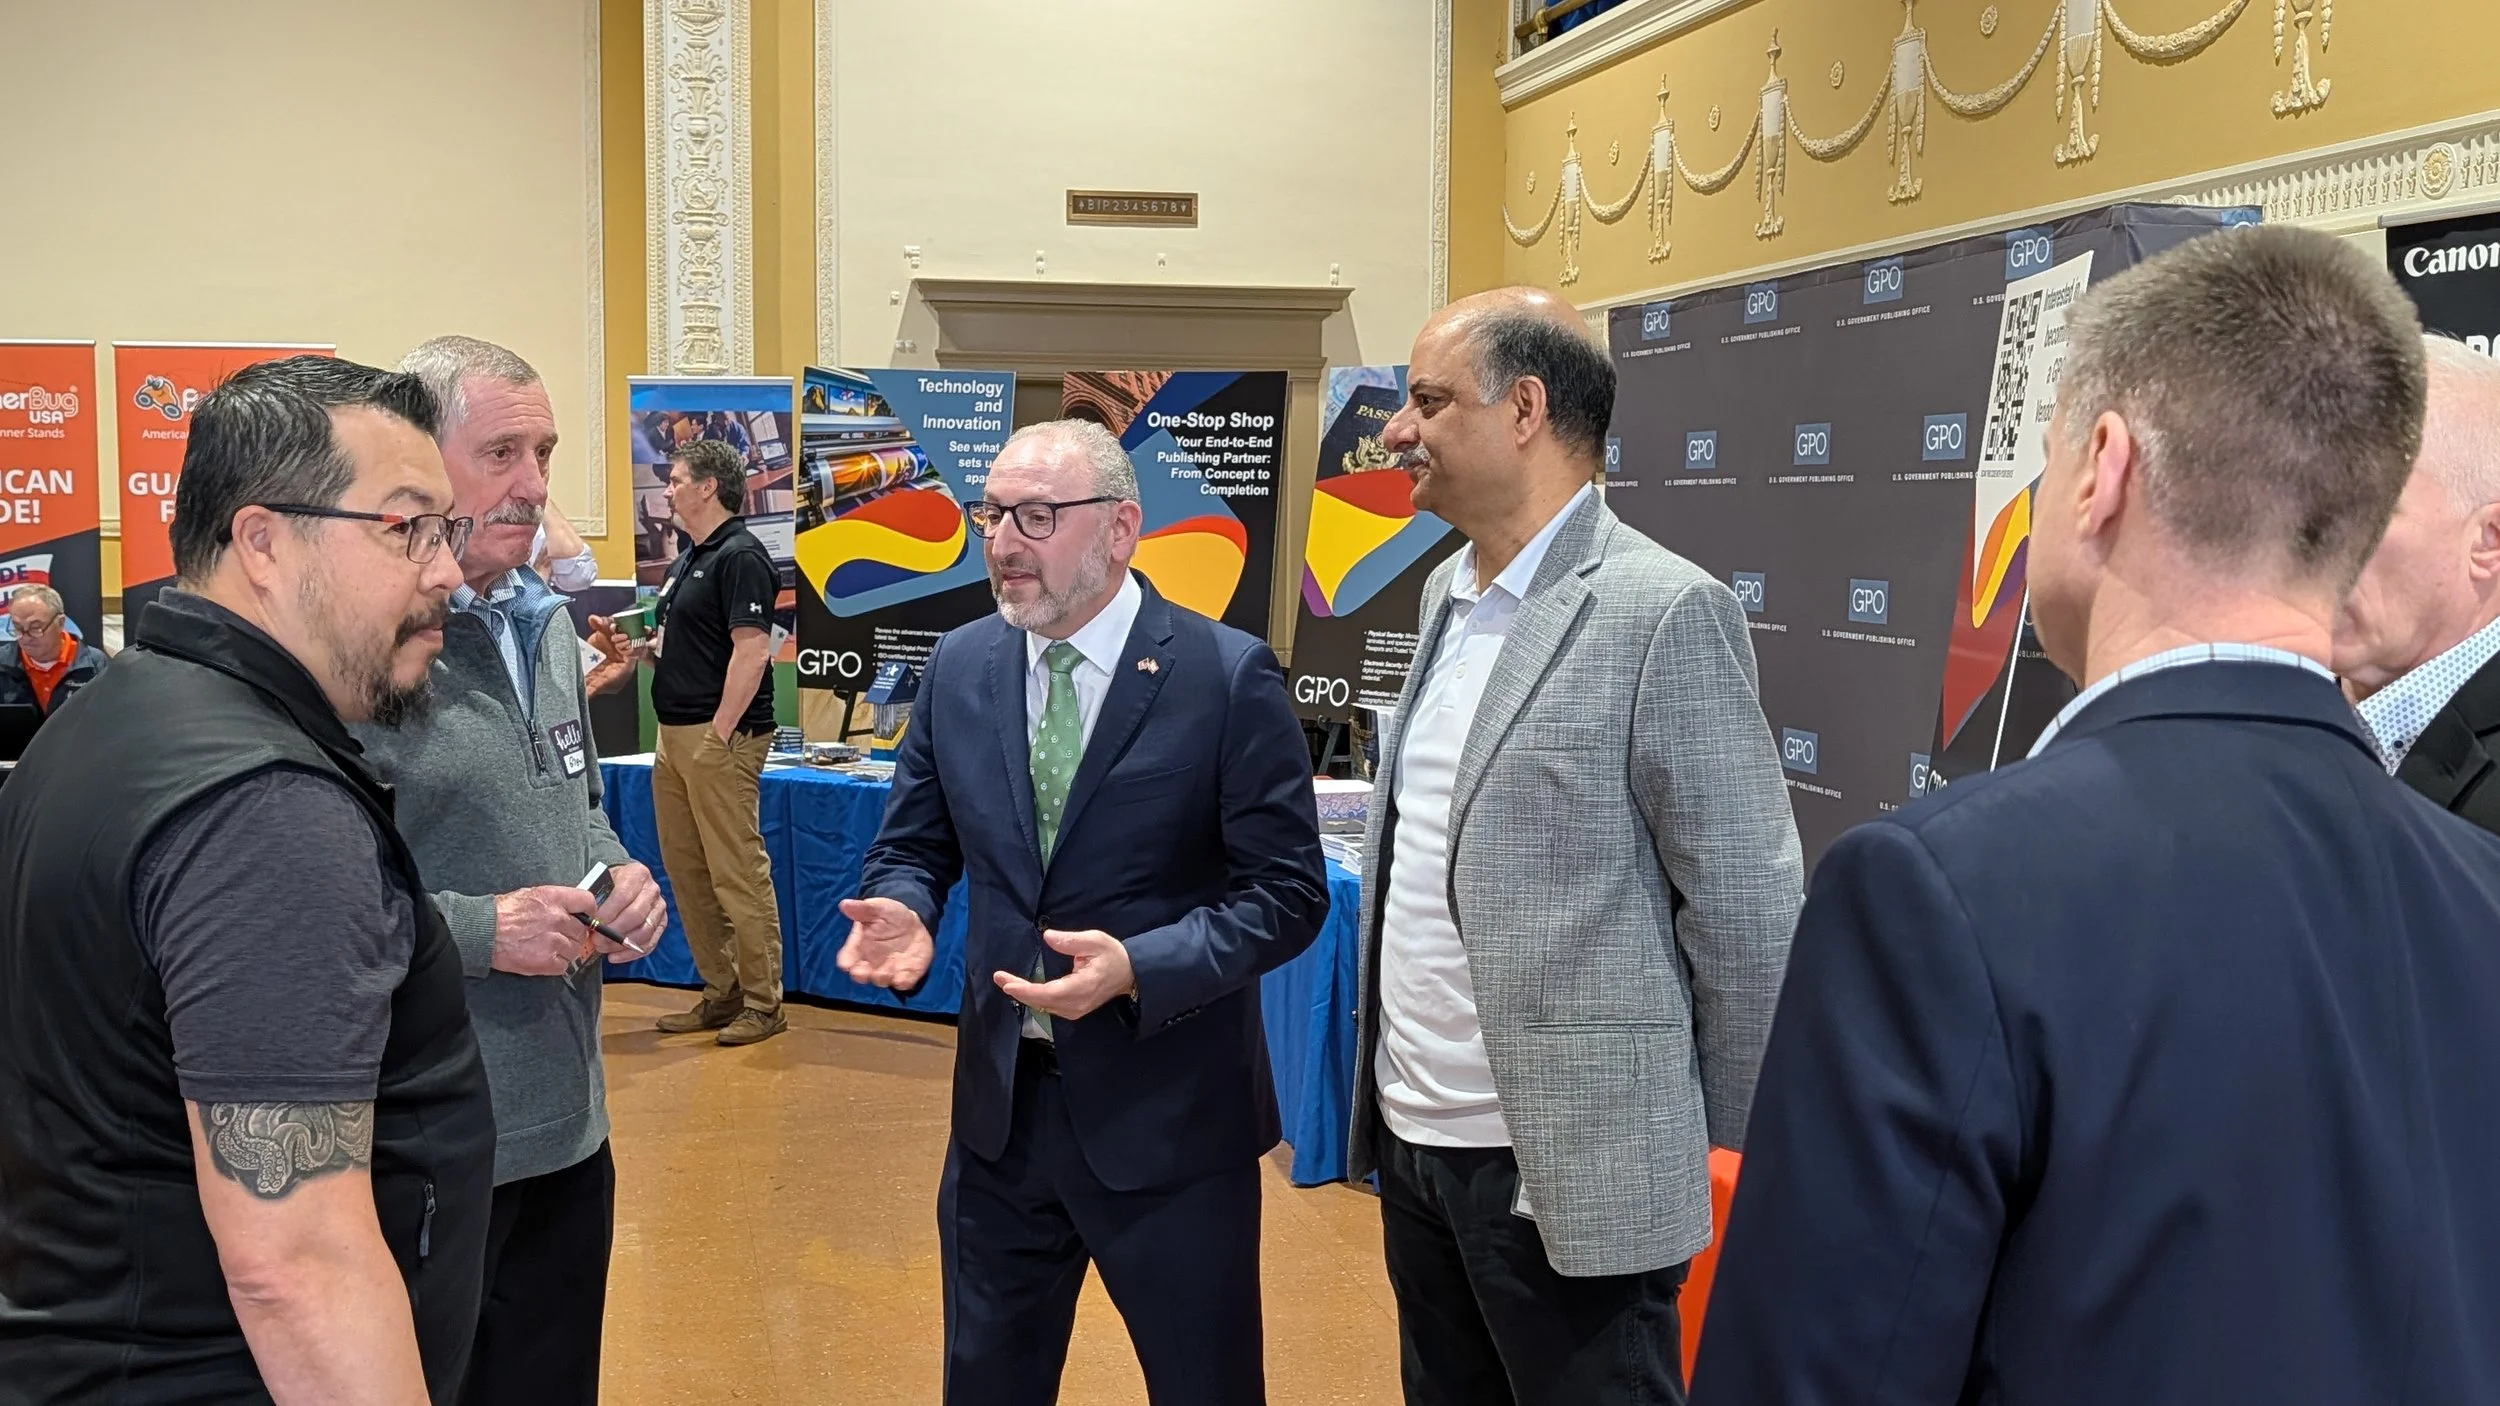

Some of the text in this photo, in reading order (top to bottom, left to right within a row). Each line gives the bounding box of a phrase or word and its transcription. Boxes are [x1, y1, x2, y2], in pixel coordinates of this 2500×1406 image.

[2010, 236, 2050, 268] GPO
[1867, 266, 1901, 294] GPO
[1747, 290, 1776, 315] GPO
[1972, 293, 2005, 305] U.S. GOVER
[2043, 278, 2075, 312] Interested
[1643, 309, 1669, 333] GPO
[1836, 305, 1931, 327] U.S. GOVERNMENT PUBLISHING OFFICE
[1730, 333, 1758, 343] GOVERNMENT
[1758, 329, 1784, 339] PUBLISHING
[1784, 326, 1801, 335] OFFICE
[918, 378, 1004, 398] Technology
[0, 386, 79, 418] erBug
[974, 399, 1003, 412] and
[29, 410, 64, 424] USA
[1147, 412, 1274, 431] One-Stop Shop
[1356, 405, 1393, 421] PASS
[923, 414, 1001, 431] Innovation
[27, 428, 65, 439] Stands
[142, 429, 187, 440] America
[1175, 436, 1273, 448] Your End-to-End
[1926, 423, 1962, 450] GPO
[949, 441, 1000, 453] See what
[1688, 439, 1714, 461] GPO
[1796, 431, 1827, 456] GPO
[958, 458, 981, 468] sets
[1157, 452, 1271, 466] Publishing Partner:
[1606, 445, 1619, 464] PO
[1170, 468, 1270, 481] From Concept to
[1779, 475, 1808, 483] GOVERNMENT
[1809, 475, 1837, 483] PUBLISHING
[1837, 474, 1854, 482] OFFICE
[1904, 473, 1939, 481] GOVERNMENT
[1940, 471, 1973, 480] PUBLISHING
[1200, 484, 1269, 497] Completion
[1734, 580, 1762, 603] GPO
[1852, 588, 1885, 614] GPO
[1747, 622, 1787, 632] UBLISHING OFFICE
[1821, 629, 1916, 647] U.S. GOVERNMENT PUBLISHING OFFICE
[797, 648, 862, 678] GPO
[1295, 675, 1349, 707] GPO
[1784, 736, 1814, 764] GPO
[1796, 781, 1824, 794] PUBLISHING
[1824, 789, 1842, 799] OFFICE
